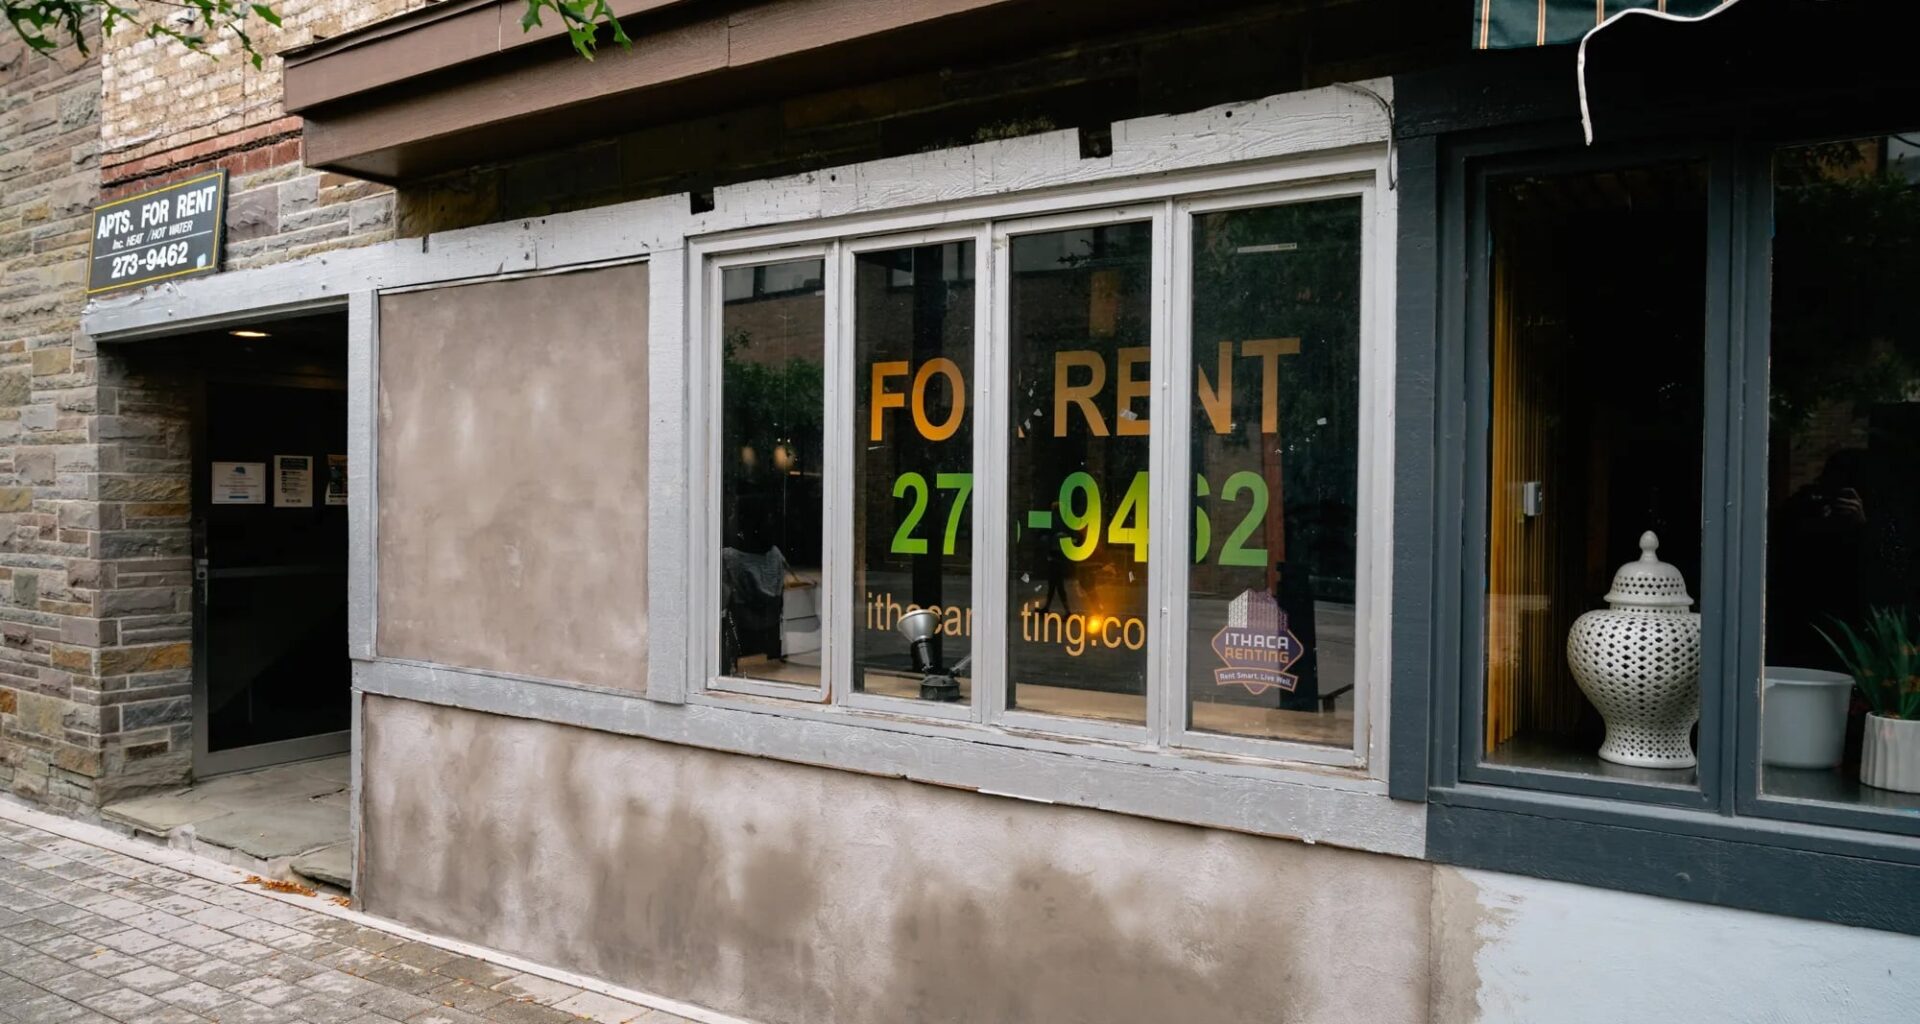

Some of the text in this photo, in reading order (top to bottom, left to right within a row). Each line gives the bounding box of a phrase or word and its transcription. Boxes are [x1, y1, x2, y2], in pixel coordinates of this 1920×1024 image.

[97, 185, 217, 239] APTS. FOR RENT
[126, 232, 144, 245] HEAT
[169, 220, 193, 236] WATER
[111, 241, 188, 279] 273-9462
[869, 357, 1025, 441] FO
[890, 471, 1269, 567] 27-942
[1224, 647, 1289, 664] RENTING
[1225, 632, 1289, 650] ITHACA
[1220, 671, 1292, 686] Rent Smart. Live Well.
